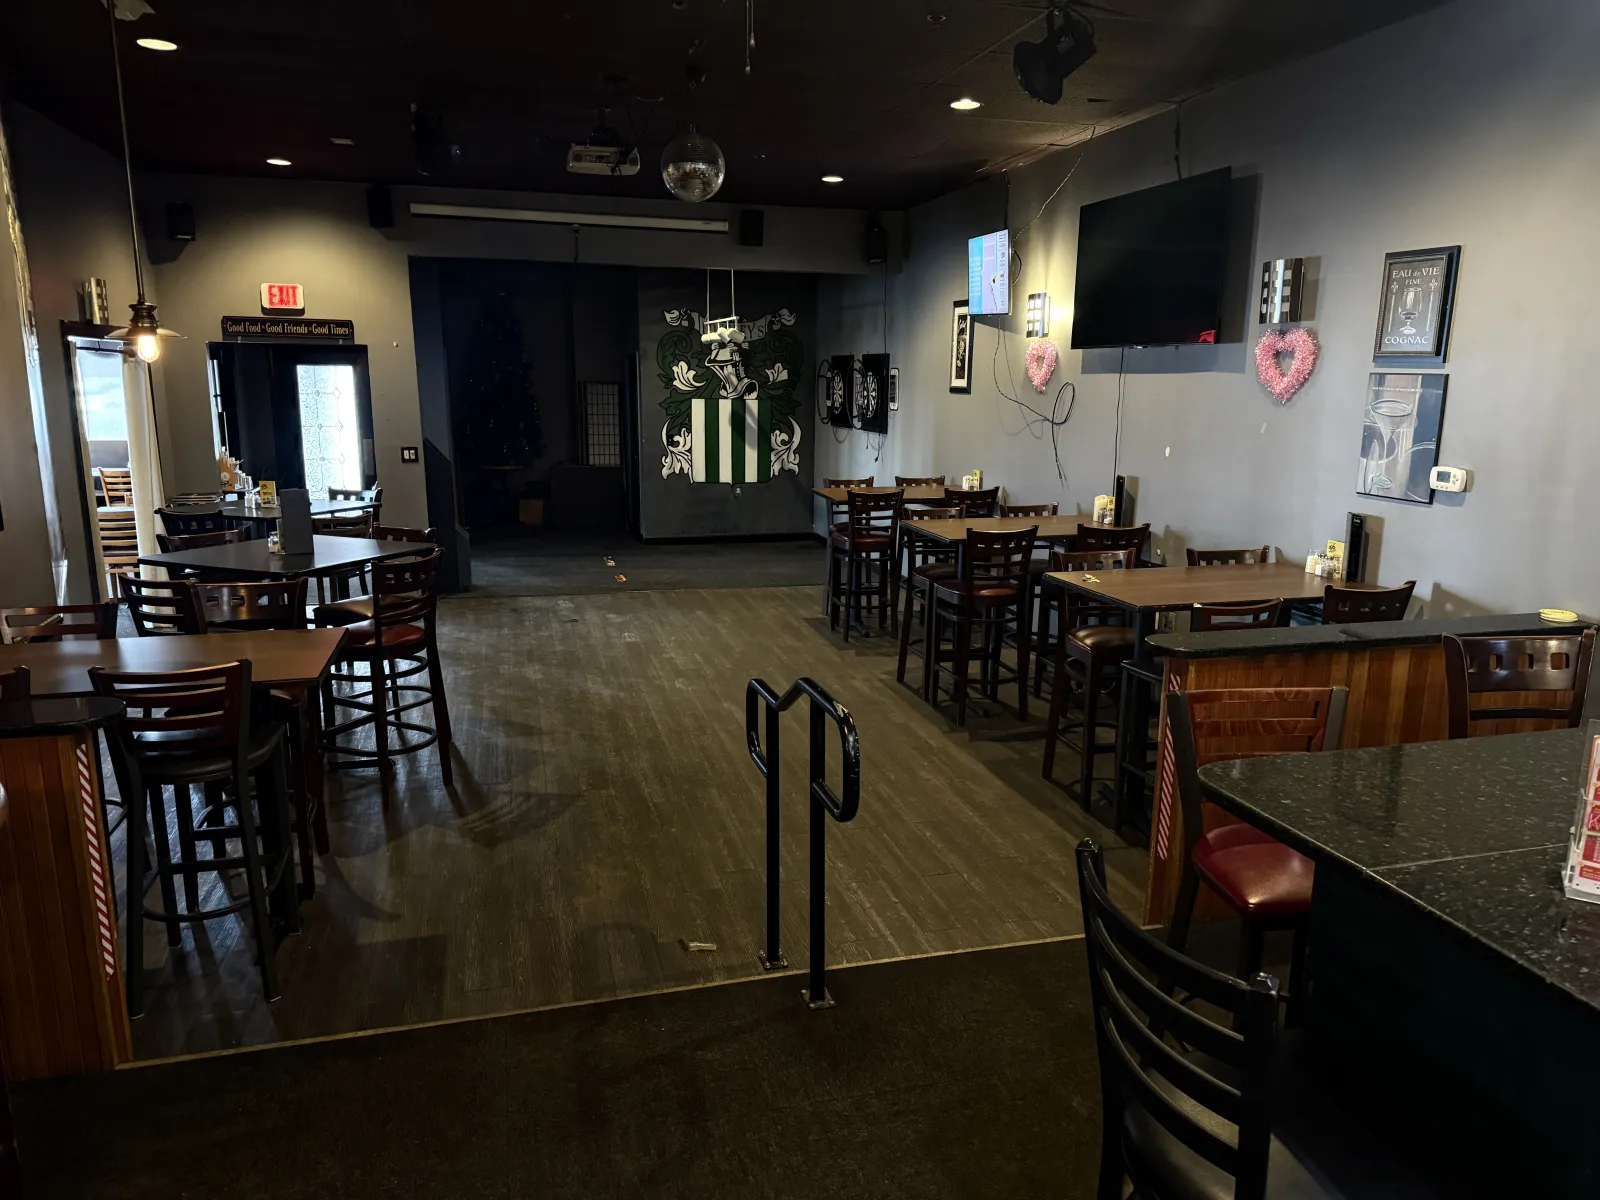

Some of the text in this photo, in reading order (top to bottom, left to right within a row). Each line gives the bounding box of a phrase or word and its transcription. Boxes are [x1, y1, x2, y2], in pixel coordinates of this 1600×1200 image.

[1392, 269, 1412, 279] EAU
[1421, 266, 1440, 277] VIE
[268, 284, 298, 307] EXIT
[227, 321, 349, 335] Good Food Good Friends Good Times
[1384, 335, 1429, 344] COGNAC
